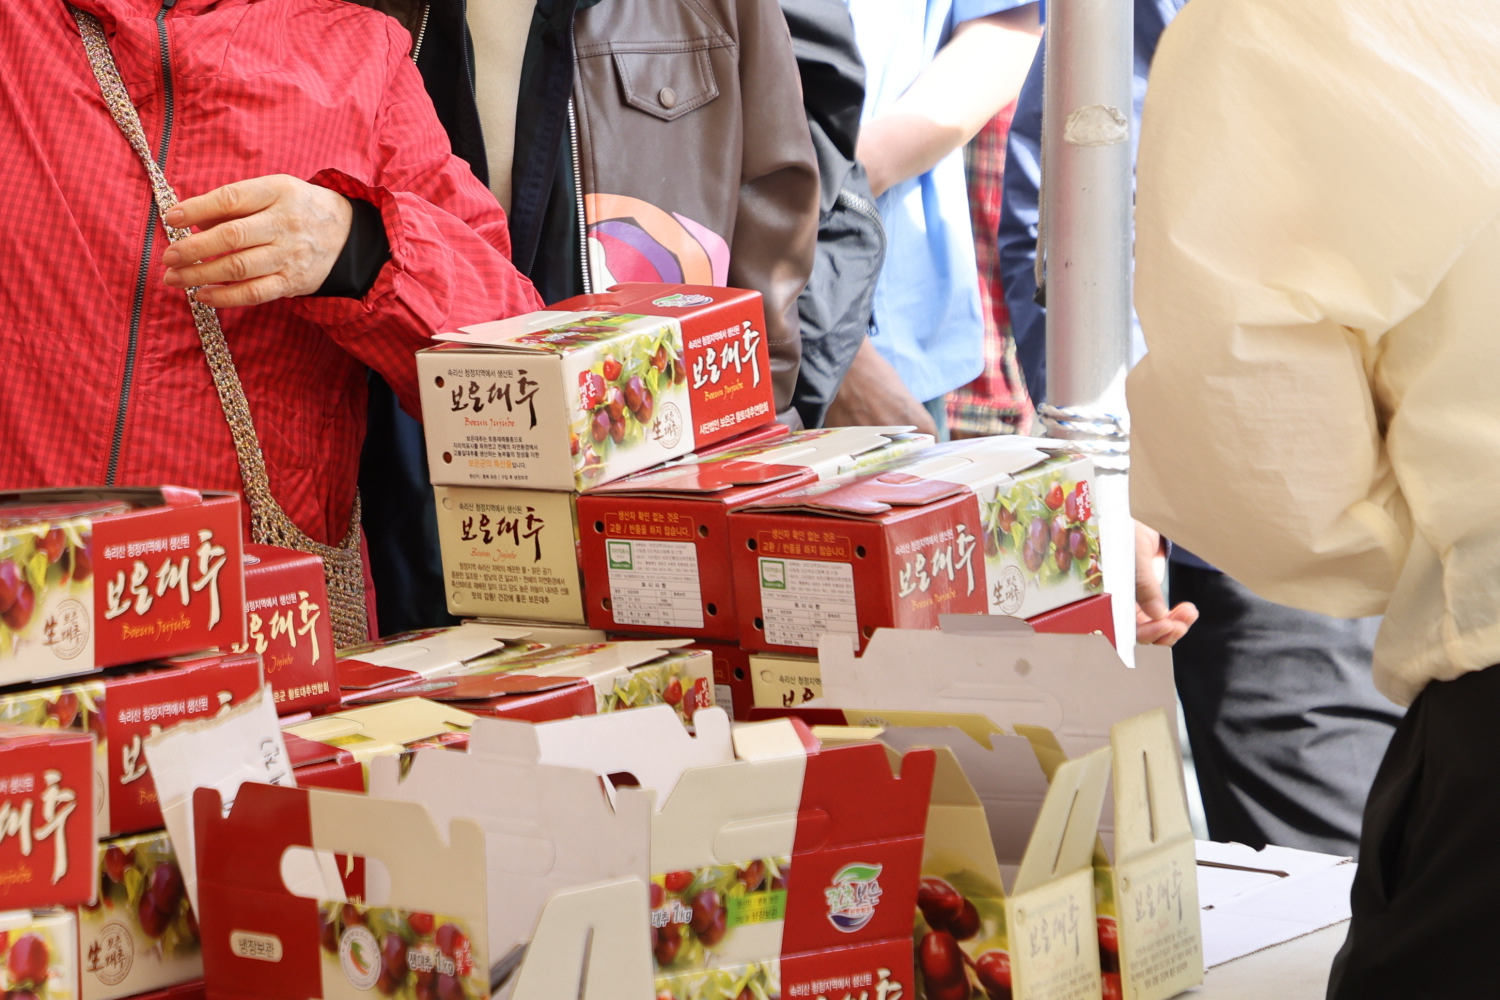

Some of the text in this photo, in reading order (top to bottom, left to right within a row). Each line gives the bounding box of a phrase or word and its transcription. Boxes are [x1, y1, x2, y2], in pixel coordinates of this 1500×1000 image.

[688, 325, 740, 350] 속리산 청정지역에서 생산된
[692, 321, 760, 389] 보은대추
[447, 369, 513, 378] 속리산 청정지역에서 생산된
[585, 372, 596, 397] 보은
[451, 369, 539, 431] 보은대추
[704, 389, 723, 402] Boeun
[465, 417, 515, 432] Boeun Jujube
[720, 413, 735, 429] 보은군
[459, 503, 522, 514] 속리산 청정지역에서 생산된
[618, 510, 680, 524] 생산자 확인 없는 것은
[461, 506, 545, 563] 보은대추
[610, 523, 622, 534] 교환
[629, 524, 648, 535] 반품을
[650, 525, 662, 536] 하지
[772, 529, 836, 544] 생산자 확인 없는 것은
[104, 534, 190, 560] 속리산 청정지역에서 생산된
[763, 542, 775, 552] 교환
[783, 543, 802, 555] 반품을
[805, 545, 817, 556] 하지
[894, 543, 910, 555] 속리산
[898, 524, 976, 598] 보은대추
[104, 529, 226, 631] 보은대추
[280, 593, 297, 606] 생산된
[42, 615, 60, 646] 生
[122, 613, 192, 641] Boeun Jujube
[231, 591, 320, 666] 은대추
[288, 681, 330, 701] 황토대추연합회
[779, 675, 796, 685] 속리산
[119, 697, 208, 725] 속리산 청정지역에서 생산된
[10, 773, 35, 794] 생산된
[1135, 860, 1183, 926] 보은대추
[652, 903, 692, 927] 대추 1kg
[1030, 894, 1080, 960] 보은대추
[107, 935, 122, 949] 보은
[239, 938, 275, 959] 냉장보관
[105, 951, 127, 970] 대추
[408, 950, 455, 976] 생대추 1kg
[789, 983, 810, 997] 속리산
[811, 977, 851, 995] 청정지역에서
[852, 972, 872, 988] 생산된
